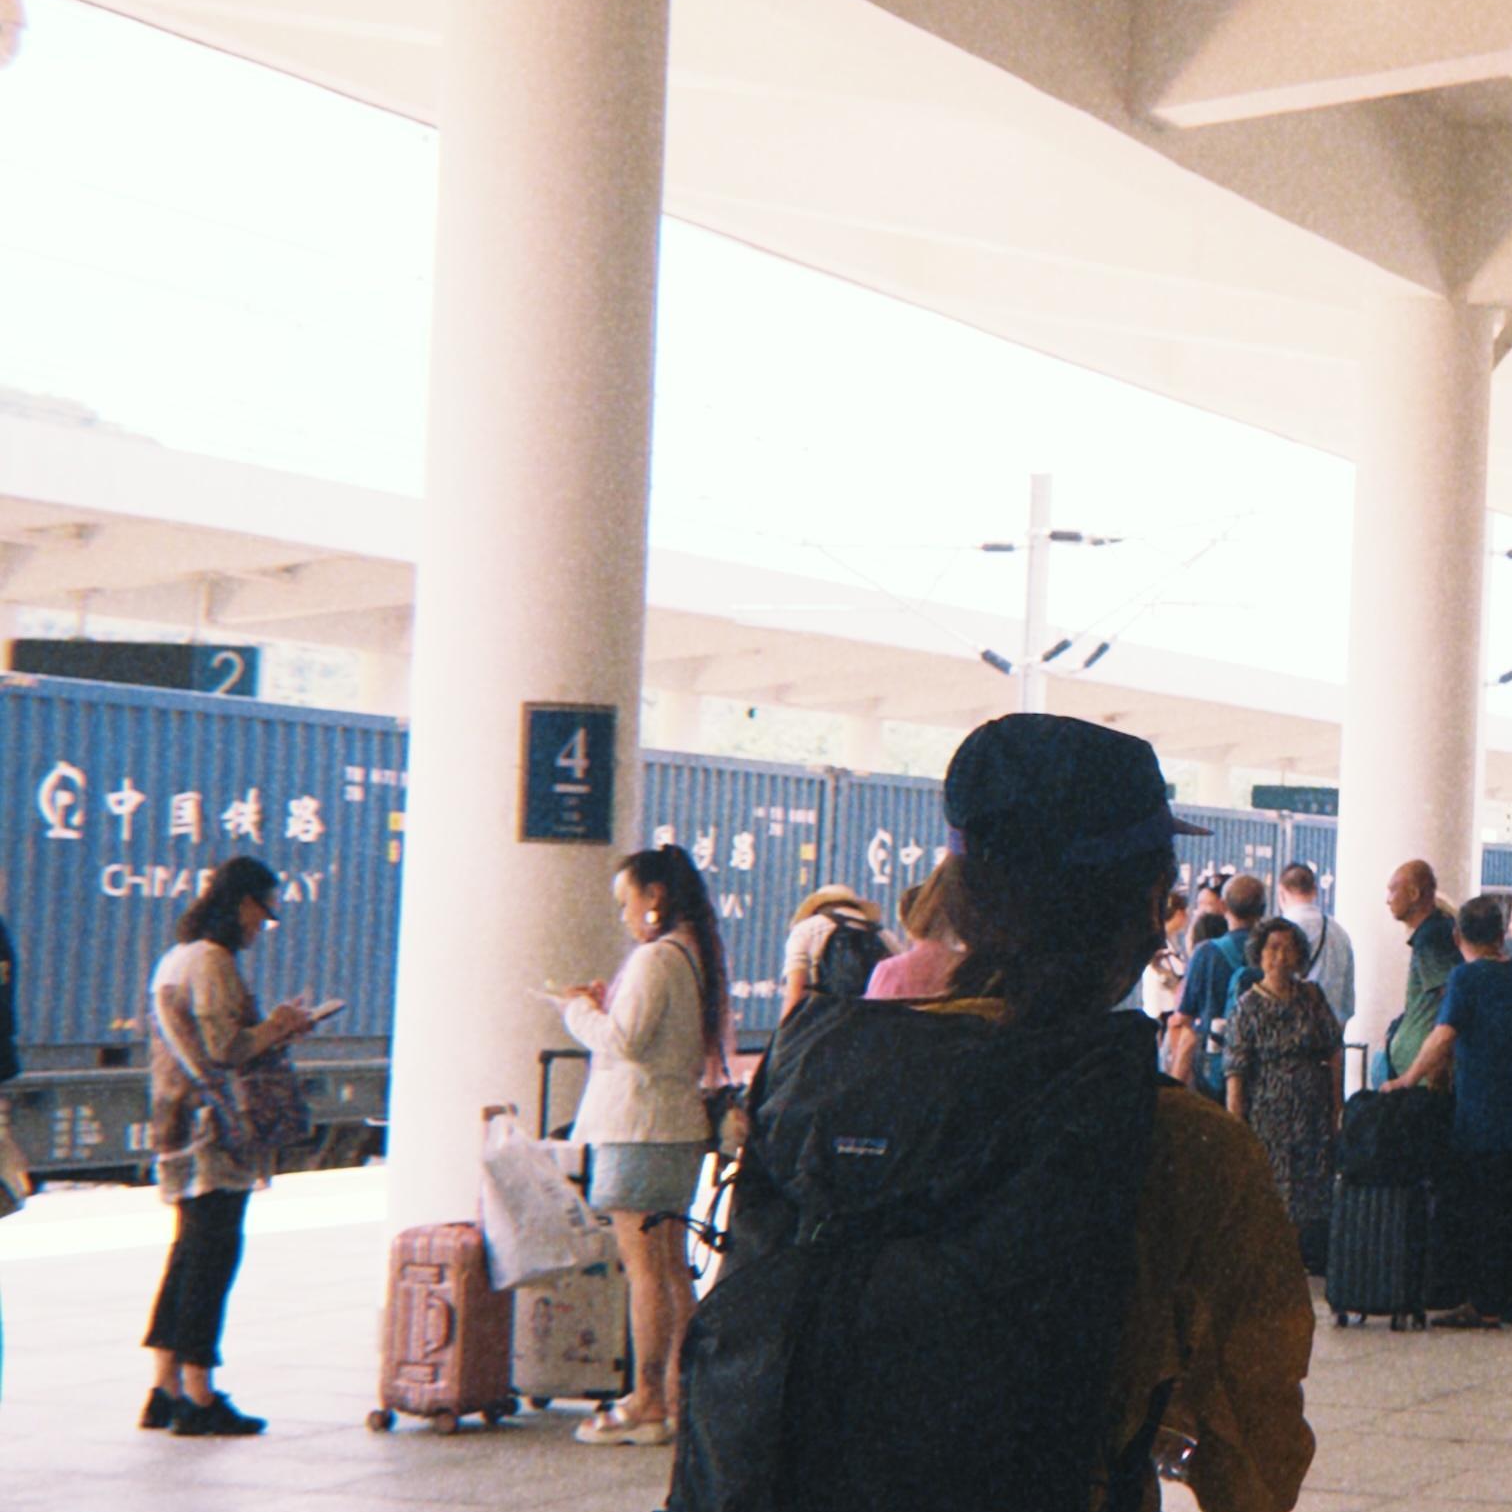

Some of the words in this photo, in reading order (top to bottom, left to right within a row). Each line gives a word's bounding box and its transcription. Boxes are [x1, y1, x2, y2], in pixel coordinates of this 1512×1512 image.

[210, 650, 245, 695] 2
[555, 726, 590, 779] 4
[105, 776, 326, 845] 中国铁路
